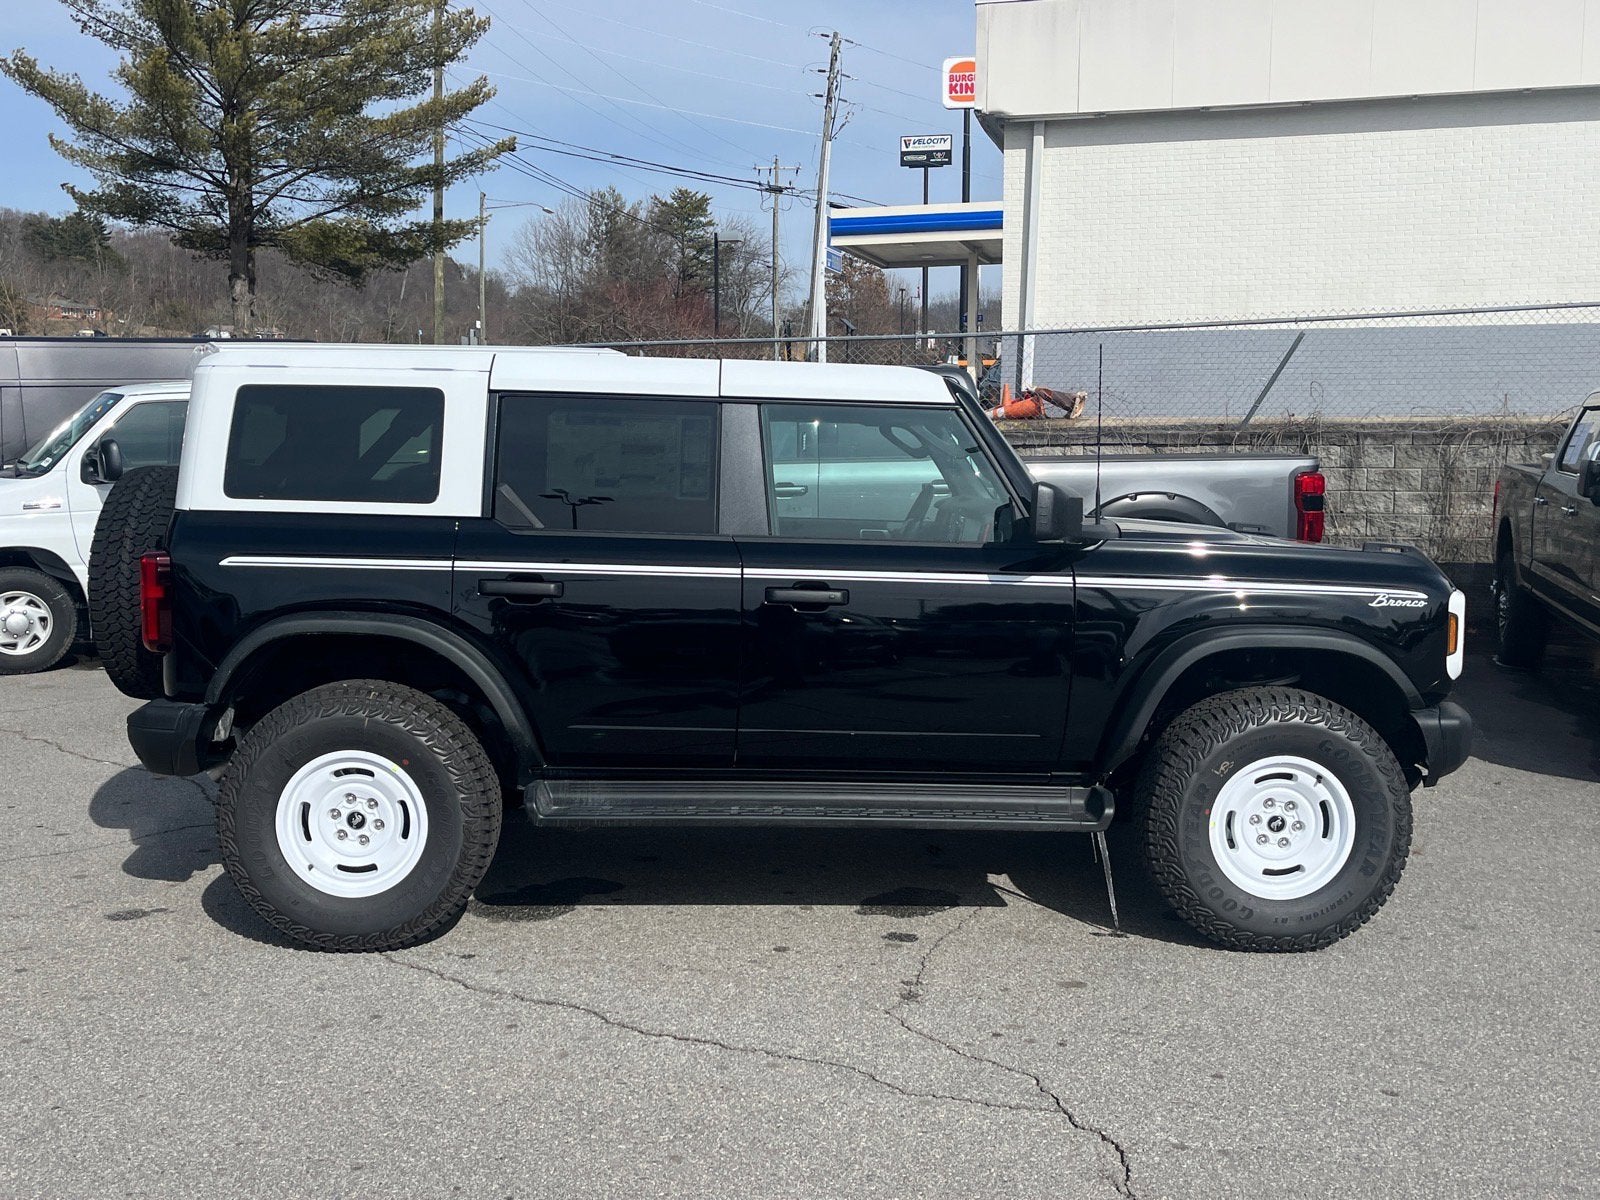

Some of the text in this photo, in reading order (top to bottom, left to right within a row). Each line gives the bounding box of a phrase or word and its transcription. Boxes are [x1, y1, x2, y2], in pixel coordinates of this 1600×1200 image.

[949, 74, 976, 82] BURG
[912, 137, 949, 145] VELOCITY
[1368, 593, 1428, 608] Bronco
